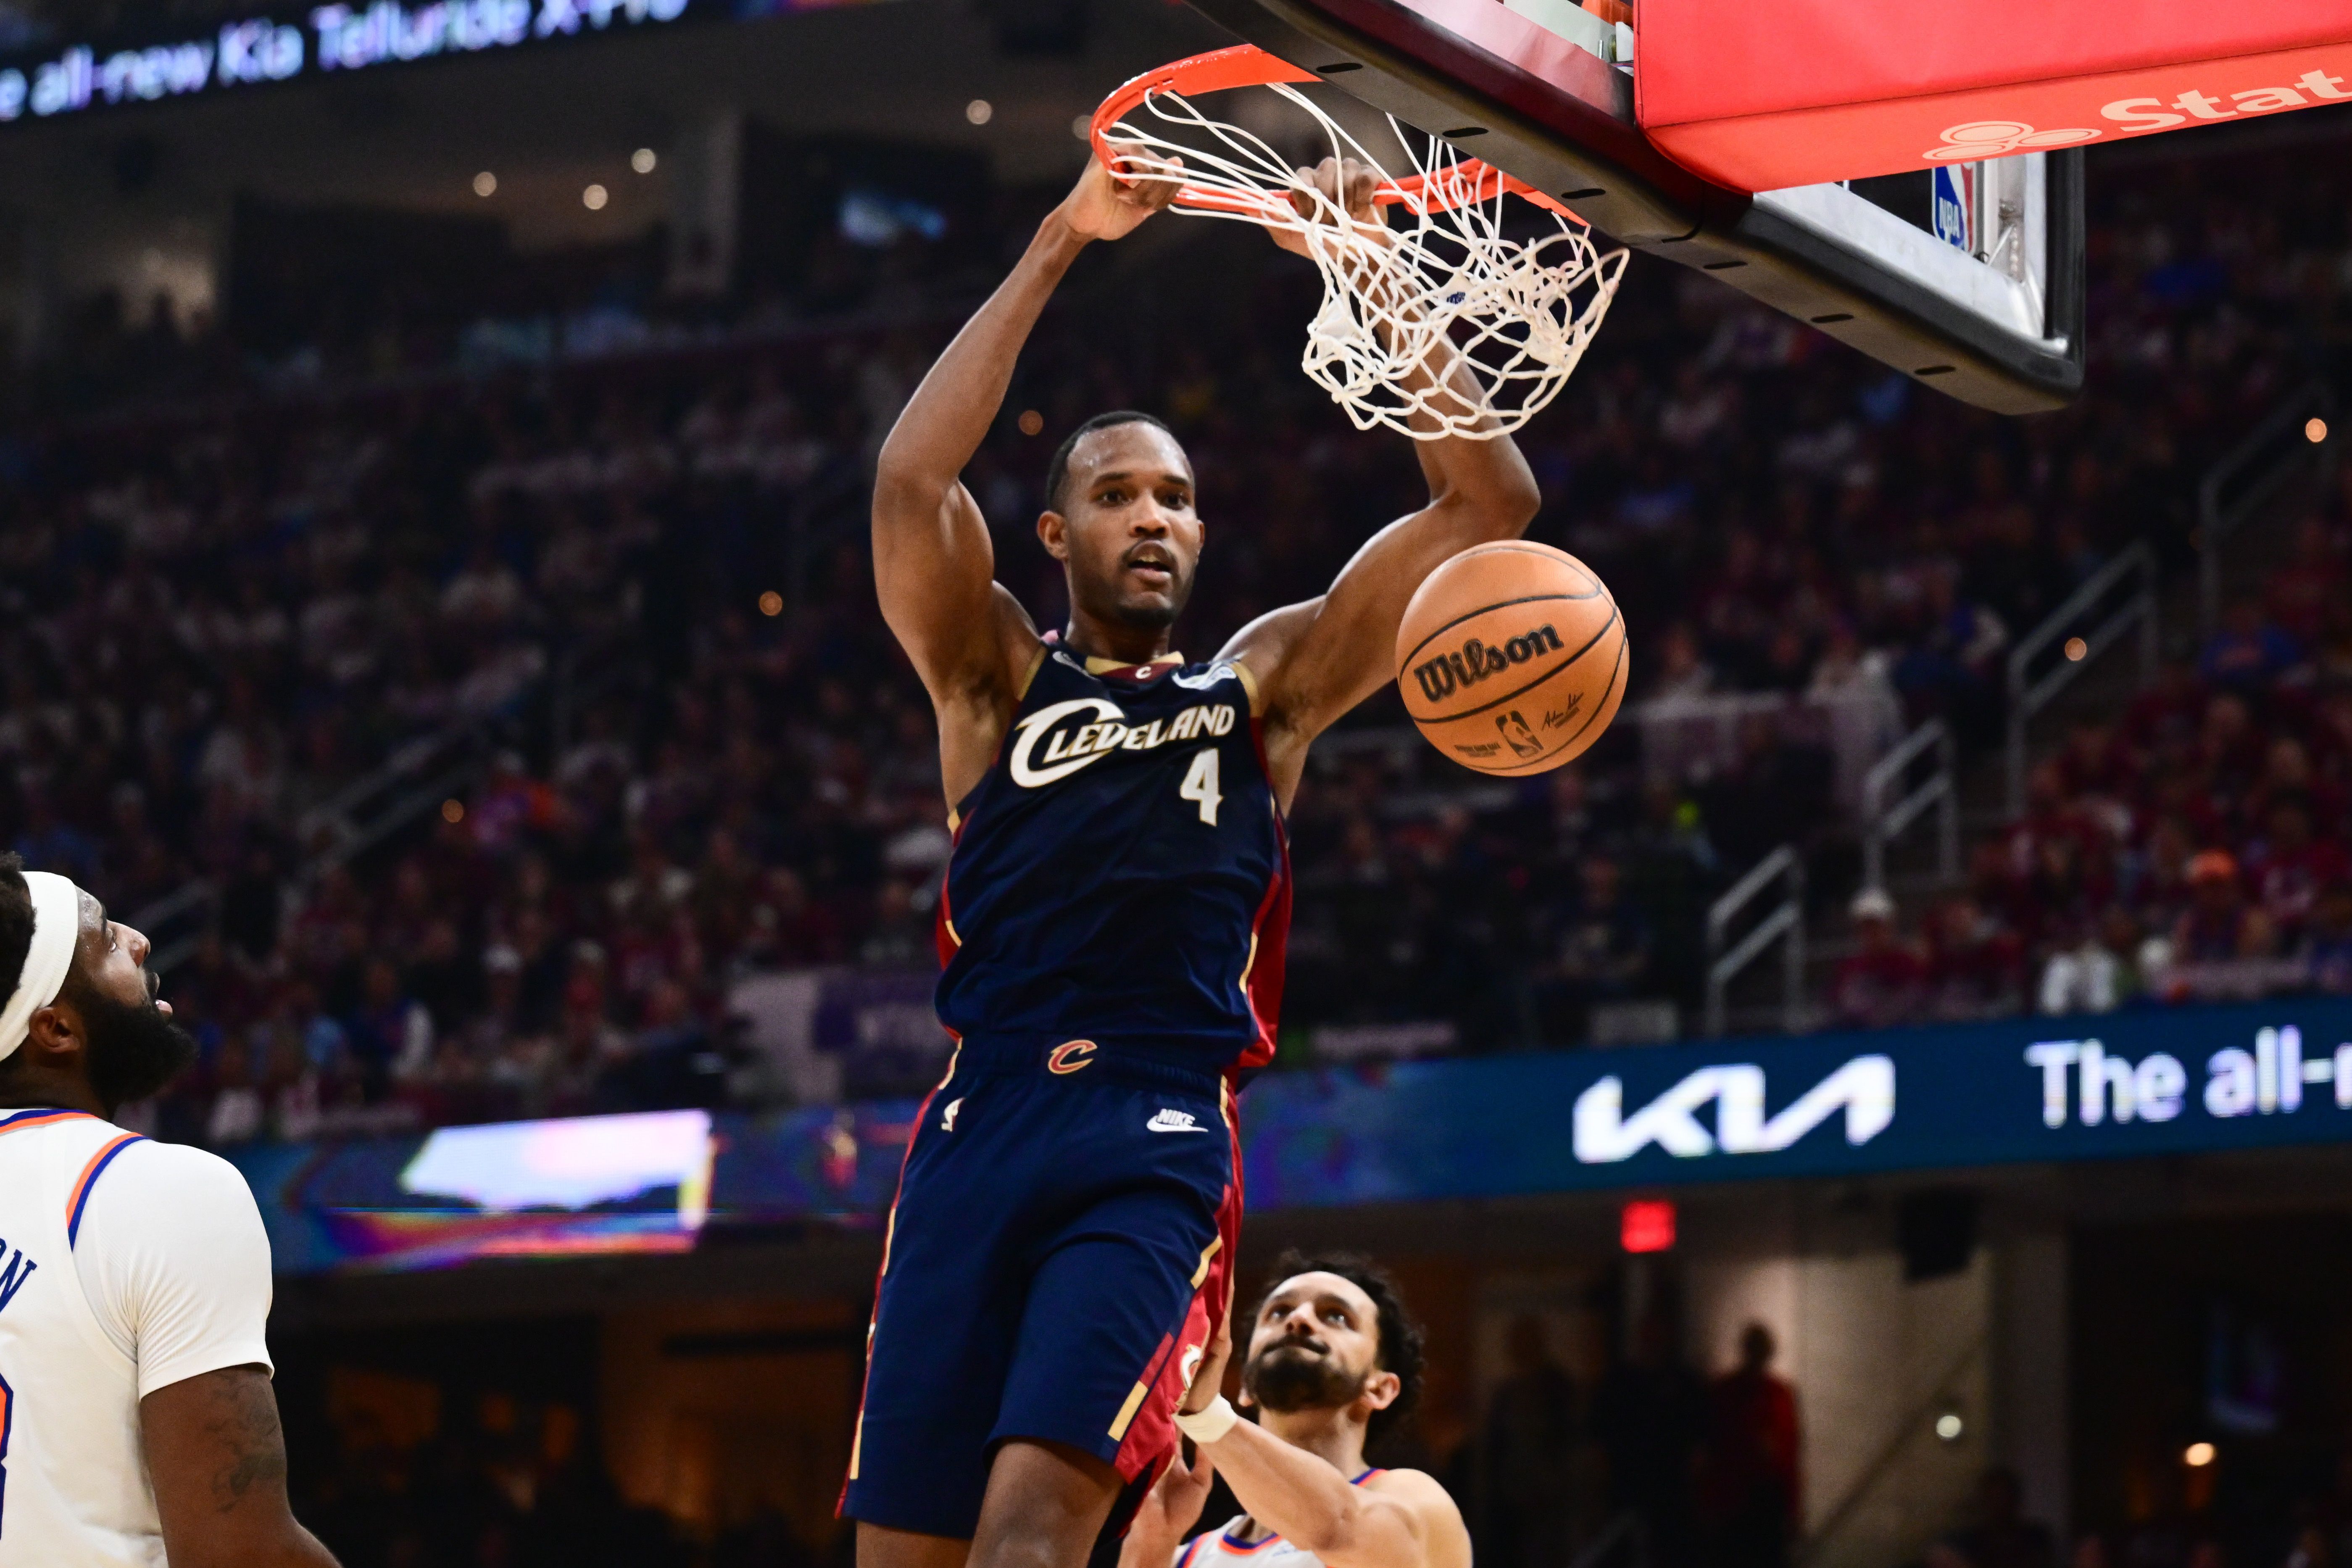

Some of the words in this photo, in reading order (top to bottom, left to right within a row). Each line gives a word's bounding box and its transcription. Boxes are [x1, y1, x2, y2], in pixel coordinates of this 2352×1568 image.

[30, 42, 214, 116] all-new
[218, 18, 303, 86] Kia
[309, 0, 530, 71] Telluride
[2100, 70, 2352, 132] Stat
[1939, 197, 1961, 239] NBA
[1413, 624, 1564, 703] Wilson
[1010, 698, 1236, 788] CLEVELAND
[1180, 748, 1223, 827] 4
[1048, 1039, 1097, 1074] C
[2024, 1038, 2187, 1128] The
[1156, 1108, 1196, 1127] NIKE
[1572, 1054, 1896, 1163] KIA
[0, 1237, 37, 1312] N
